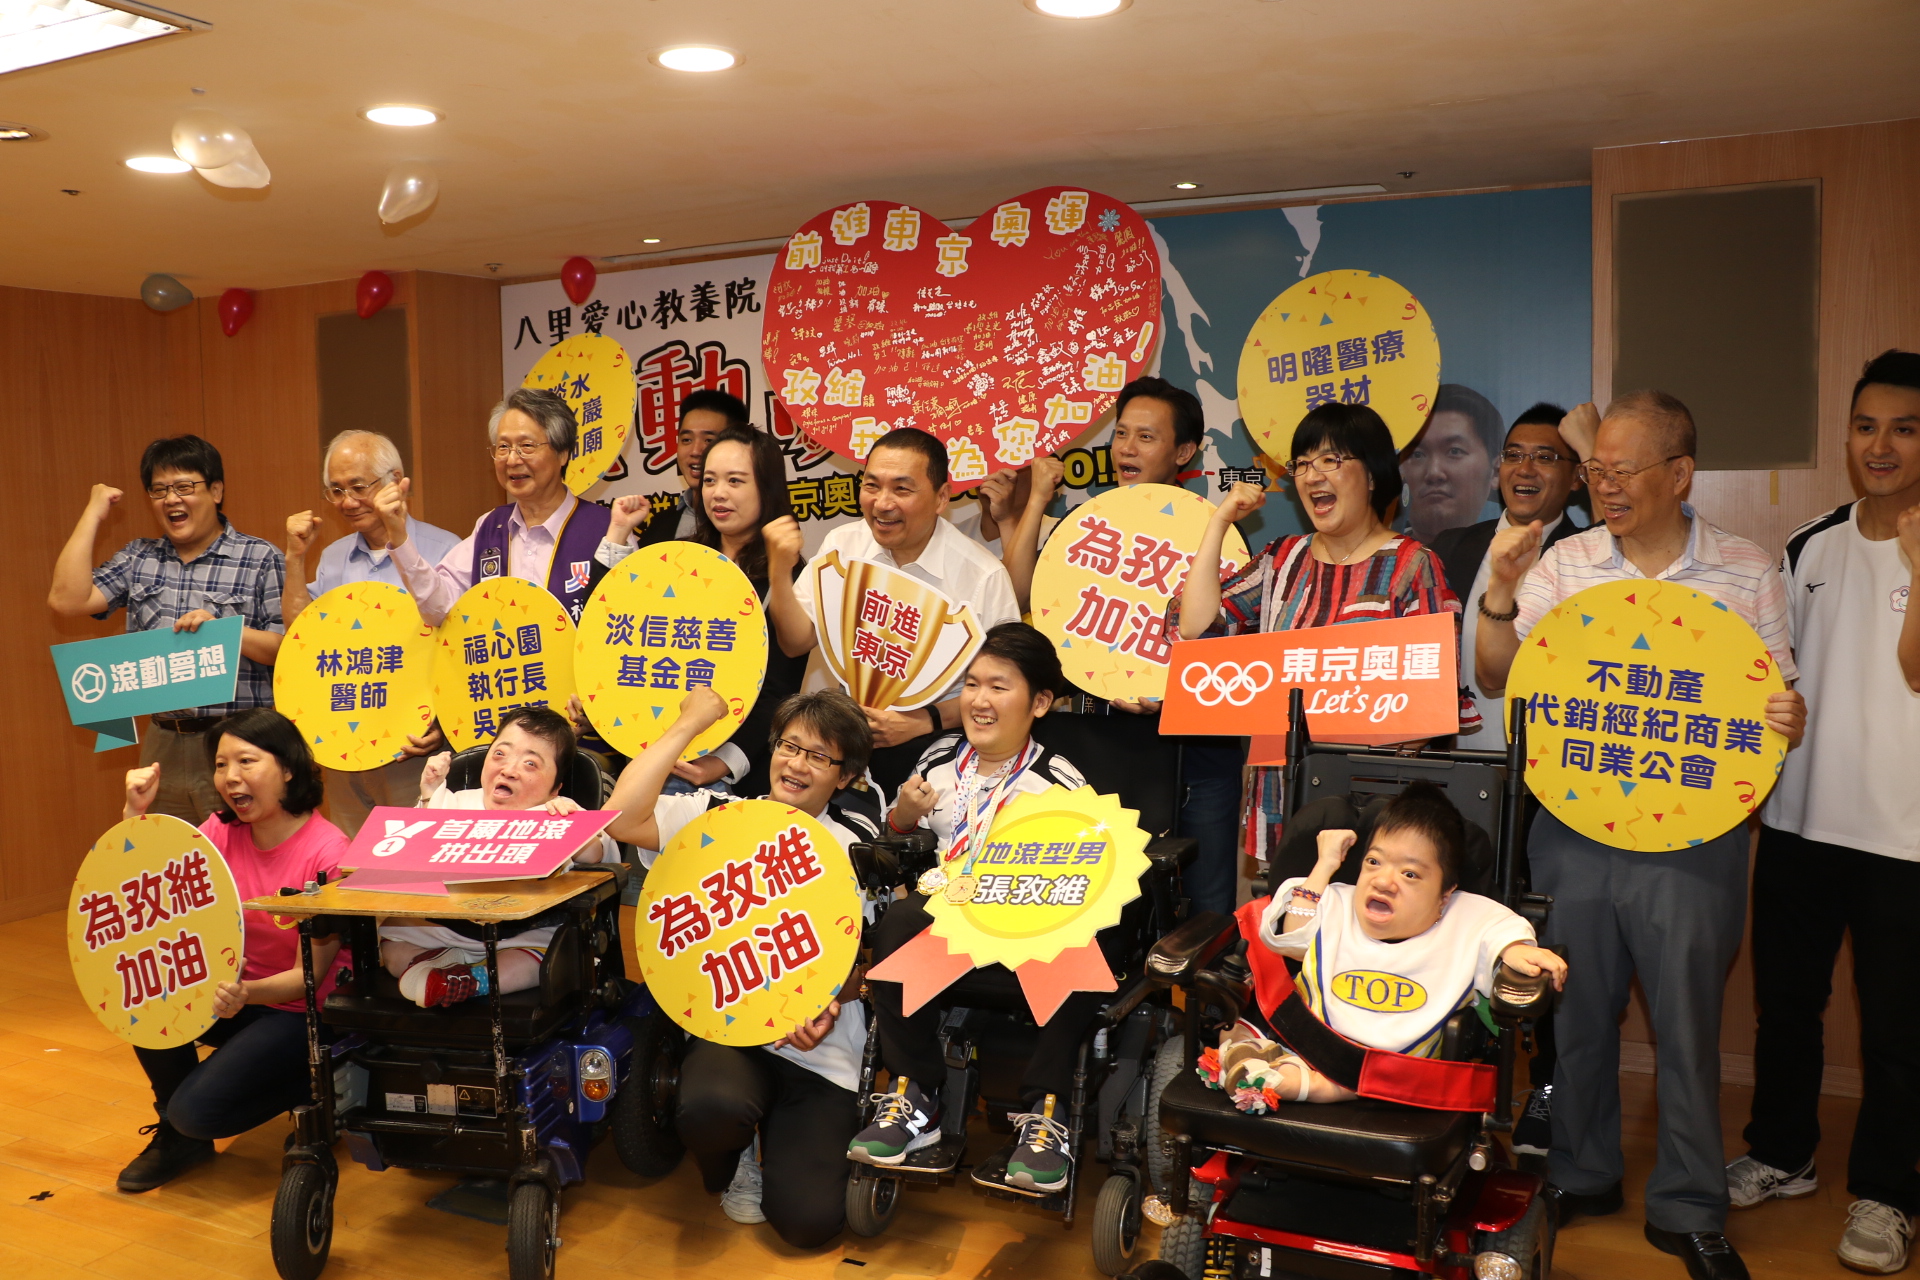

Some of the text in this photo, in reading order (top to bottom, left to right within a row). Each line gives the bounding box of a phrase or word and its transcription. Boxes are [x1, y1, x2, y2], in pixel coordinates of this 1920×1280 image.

[785, 191, 1090, 279] 前進東京奧運
[514, 276, 761, 349] 八里愛心教養院
[1267, 330, 1406, 385] 明曜醫療
[574, 396, 603, 426] 巖
[1305, 374, 1372, 413] 器材
[786, 476, 866, 519] 京奧
[1222, 469, 1264, 489] 東京
[605, 613, 737, 652] 淡信慈善
[860, 589, 922, 643] 前進
[1065, 585, 1172, 666] 加油
[315, 644, 405, 678] 林鴻津
[463, 623, 543, 667] 福心園
[850, 628, 913, 681] 東京
[1280, 642, 1441, 684] 東京奧運
[109, 644, 228, 694] 滾動夢想
[467, 661, 548, 702] 執行長
[616, 654, 716, 692] 基金會
[1586, 659, 1705, 704] 不動產
[330, 681, 389, 712] 醫師
[1305, 685, 1408, 723] Let's go
[1527, 692, 1765, 755] 代銷經紀商業
[1561, 738, 1718, 790] 同業公會
[433, 819, 574, 840] 首爾地滾
[428, 843, 540, 864] 拼出頭
[978, 841, 1108, 865] 地滾型男
[79, 850, 216, 951] 為孜維
[649, 826, 823, 957] 為孜維
[974, 874, 1090, 905] 張孜維
[115, 930, 208, 1009] 加油
[701, 911, 821, 1009] 加油
[1345, 974, 1415, 1008] TOP
